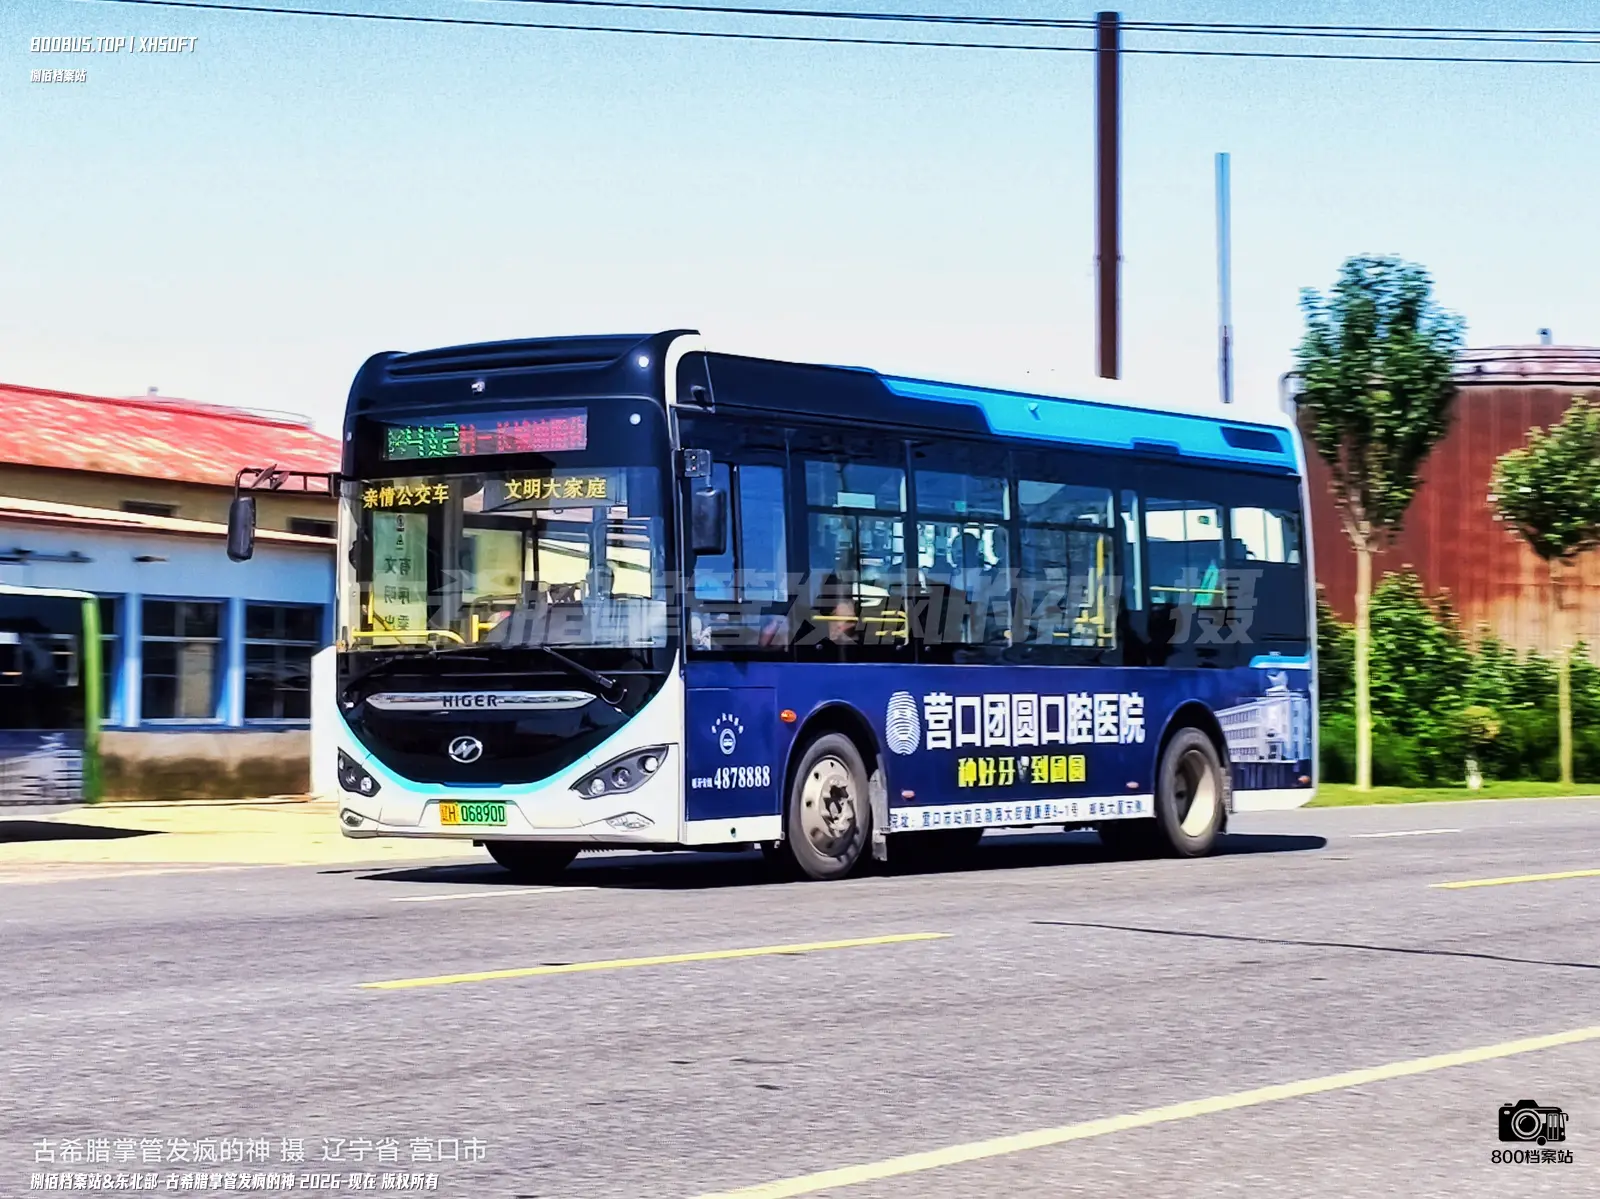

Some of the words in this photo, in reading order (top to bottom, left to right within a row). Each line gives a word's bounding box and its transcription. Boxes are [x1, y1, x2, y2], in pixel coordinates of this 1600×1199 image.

[363, 483, 450, 509] 亲情公交车
[504, 477, 608, 501] 文明大家庭
[443, 695, 498, 708] HIGER
[923, 691, 1146, 750] 营口团圆口腔医院
[714, 765, 771, 789] 4878888
